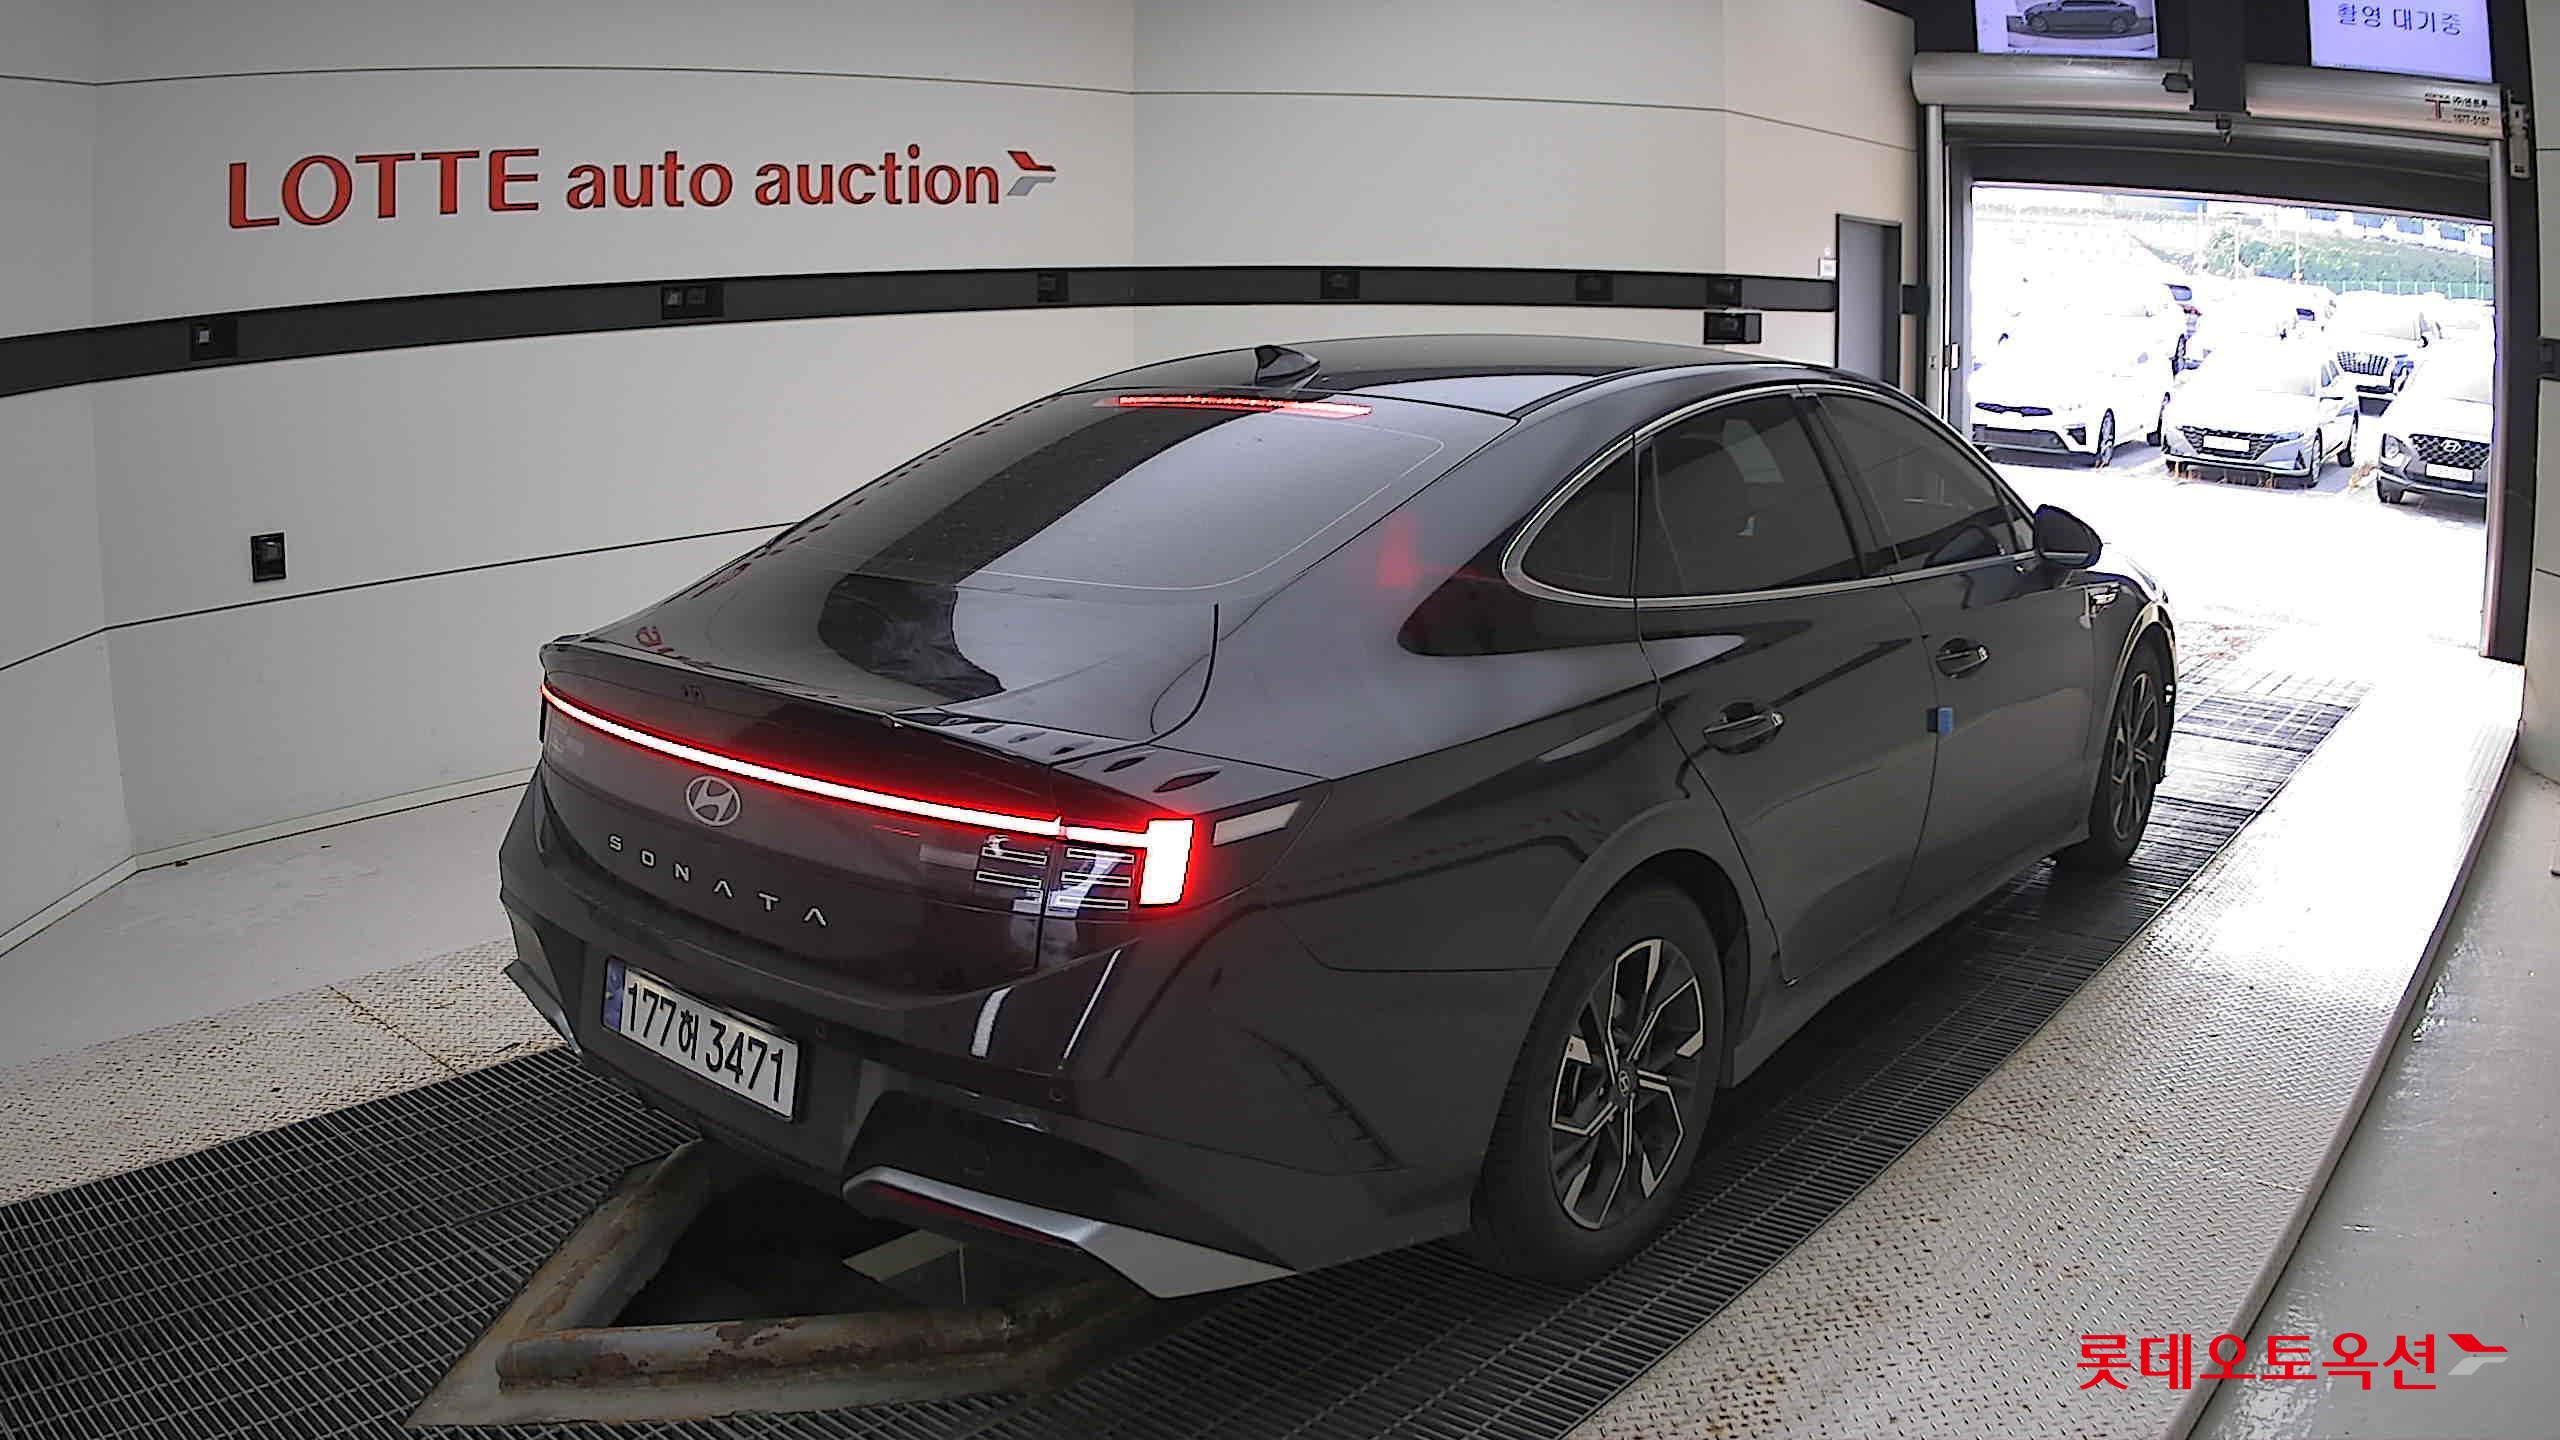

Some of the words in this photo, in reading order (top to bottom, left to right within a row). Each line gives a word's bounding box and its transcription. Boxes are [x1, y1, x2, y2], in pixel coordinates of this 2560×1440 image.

[229, 148, 540, 229] LOTTE
[566, 150, 733, 210] auto
[754, 143, 1000, 206] auction
[608, 834, 828, 927] SONATA
[706, 1018, 784, 1103] 3471
